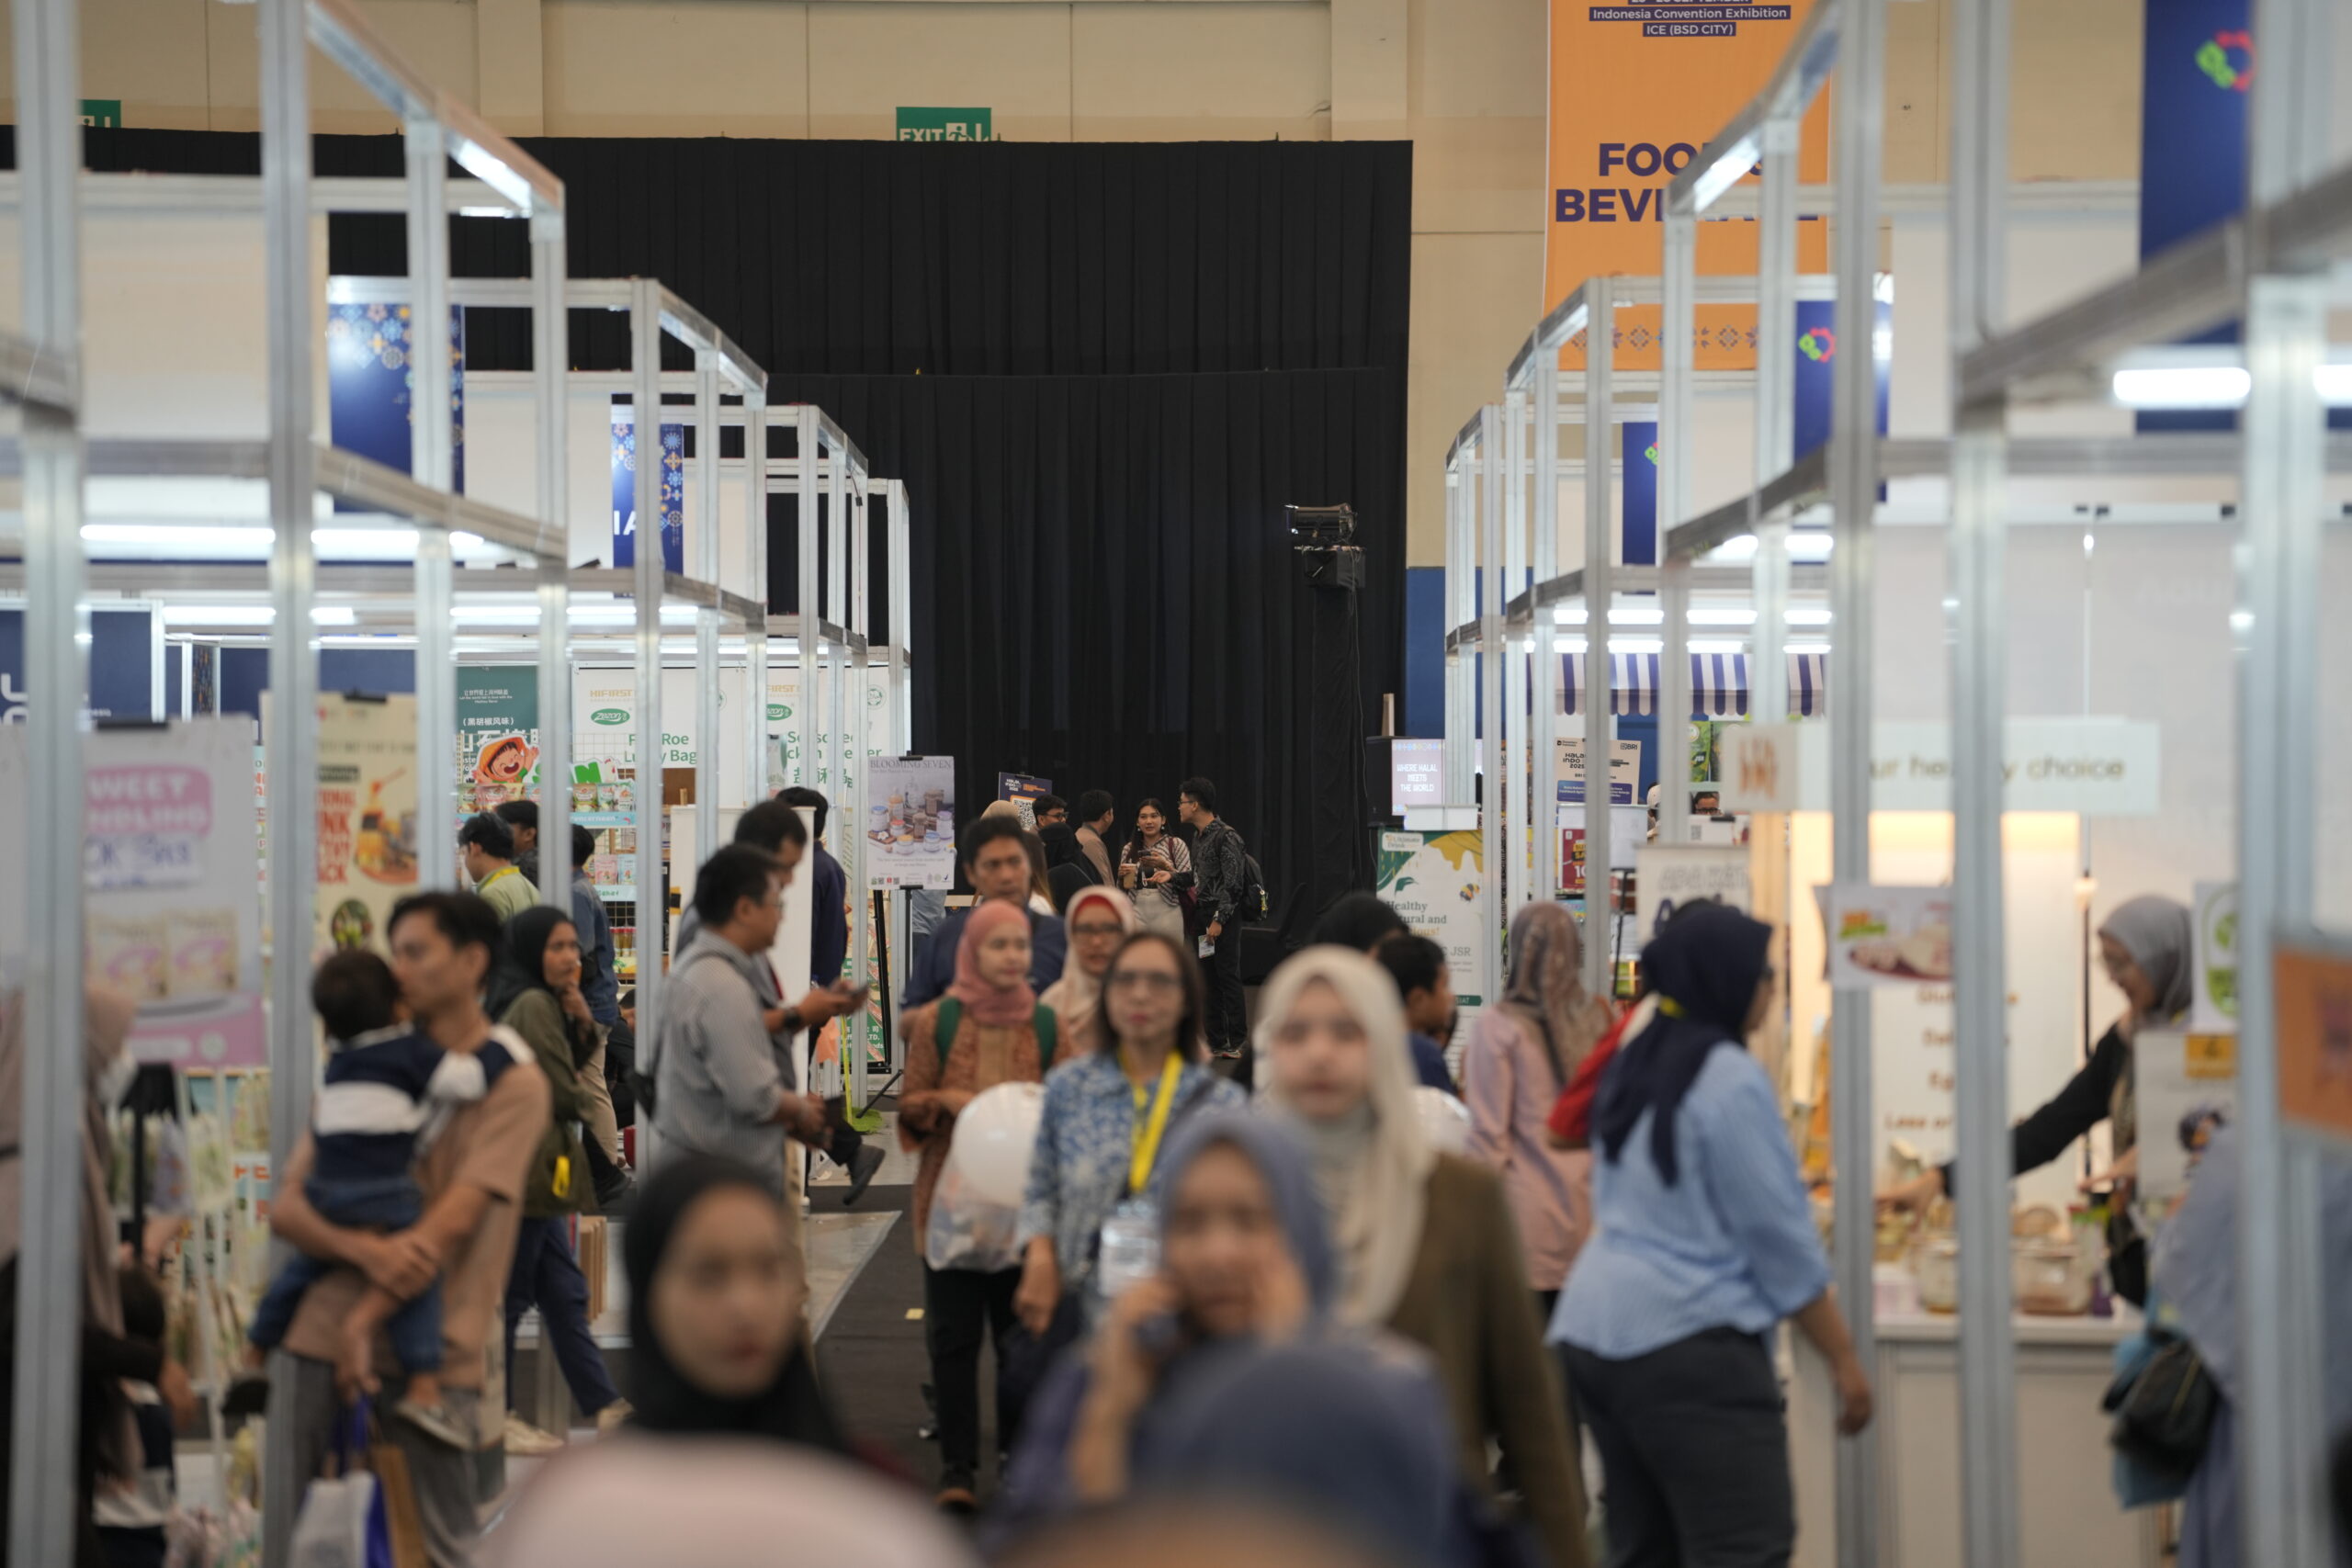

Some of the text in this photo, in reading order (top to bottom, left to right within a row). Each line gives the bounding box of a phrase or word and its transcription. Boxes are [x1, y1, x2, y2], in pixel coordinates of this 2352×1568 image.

[1593, 7, 1787, 19] Indonesia Convention Exhibition
[1646, 24, 1734, 36] ICE (BSD CITY)
[899, 128, 944, 141] EXIT
[1599, 142, 1712, 176] FOO
[662, 734, 689, 745] Roe
[87, 773, 190, 800] WEET
[1428, 915, 1448, 924] and
